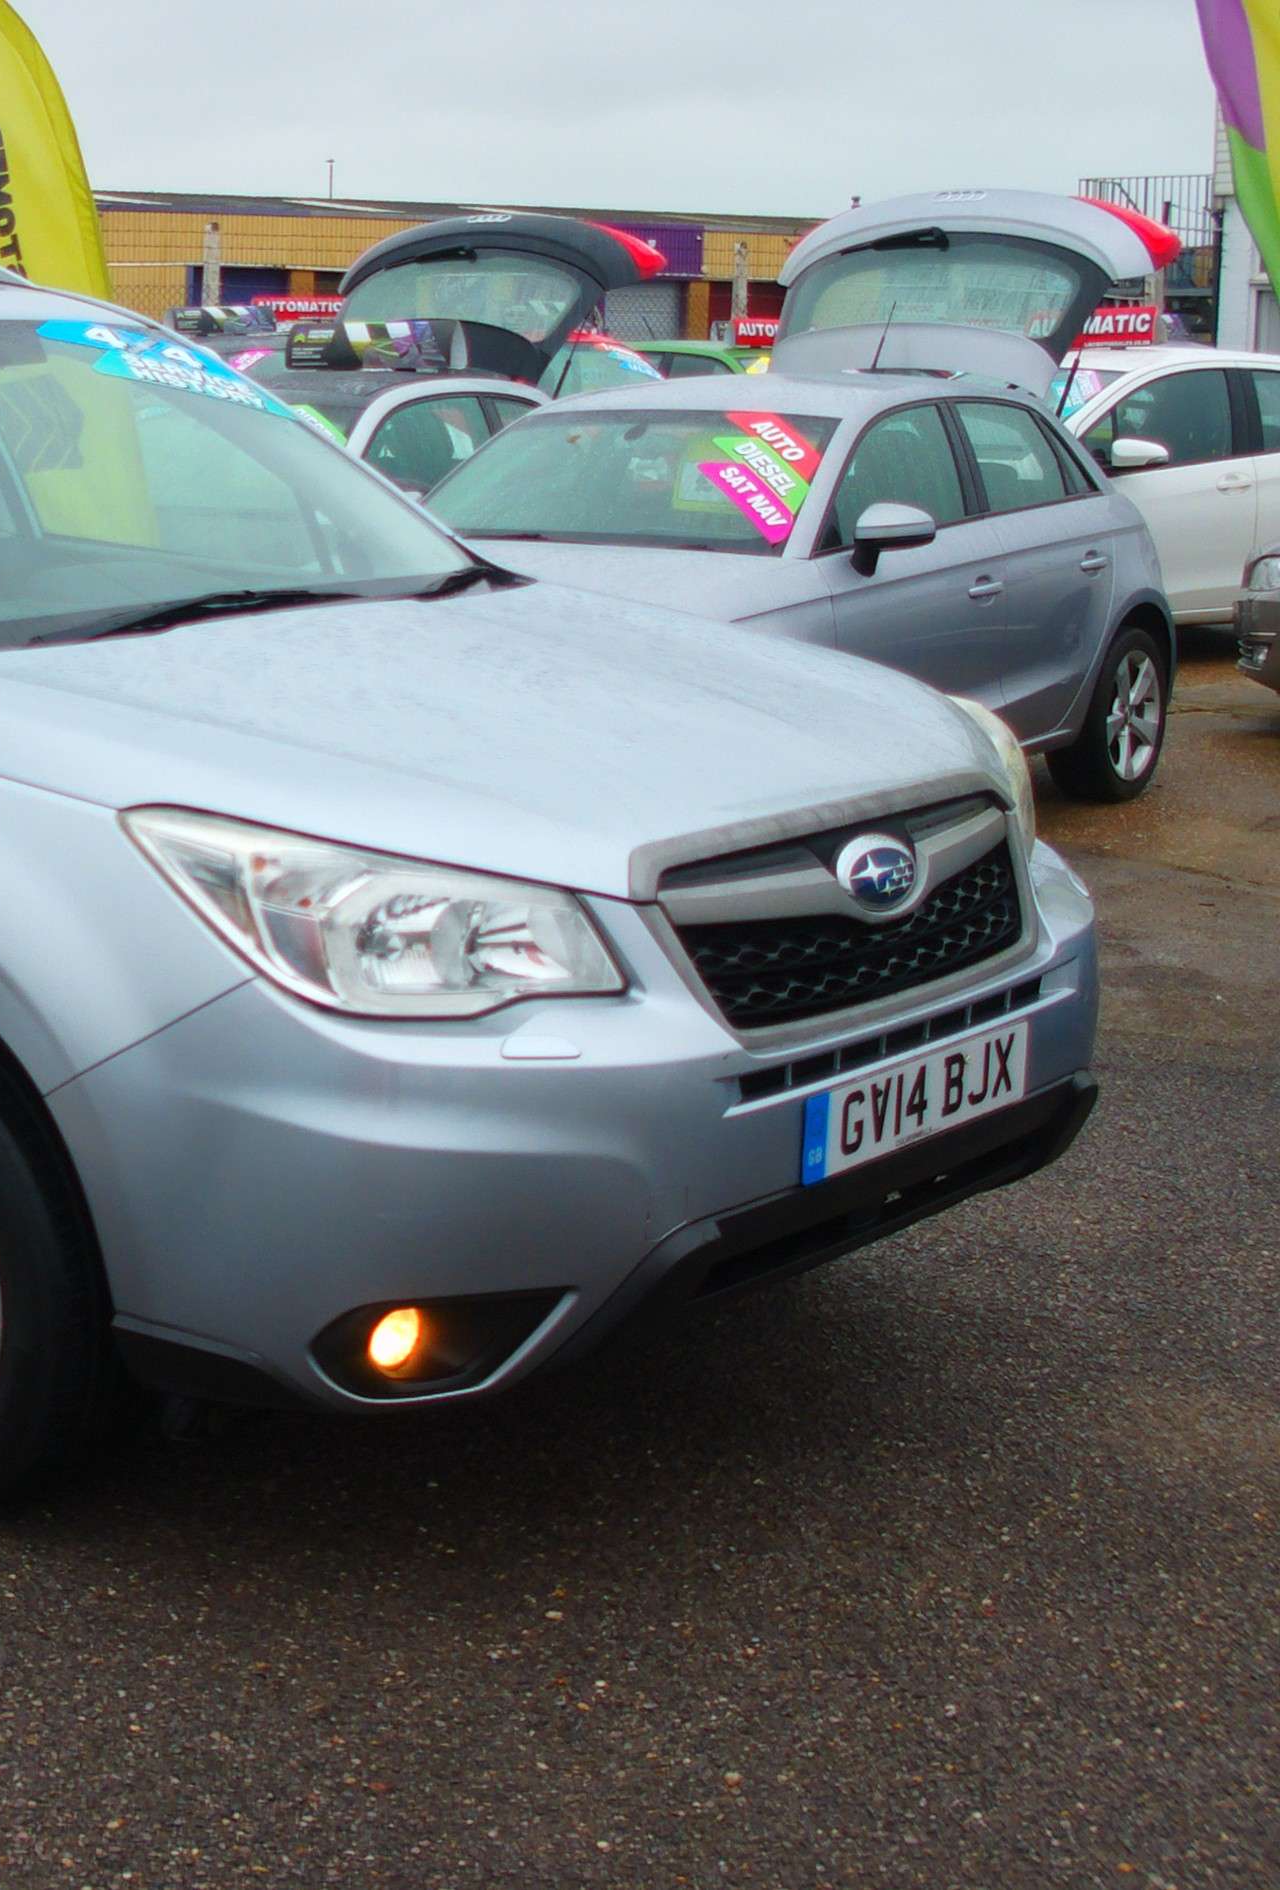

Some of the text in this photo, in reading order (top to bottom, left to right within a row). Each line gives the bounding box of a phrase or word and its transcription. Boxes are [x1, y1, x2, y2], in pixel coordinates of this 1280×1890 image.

[738, 322, 779, 337] AUTO
[128, 366, 266, 410] HISTORY
[749, 421, 805, 461] AUTO
[733, 440, 797, 497] DIESEL
[719, 466, 788, 526] SAT NAV
[839, 1032, 1016, 1156] GV14 BJX
